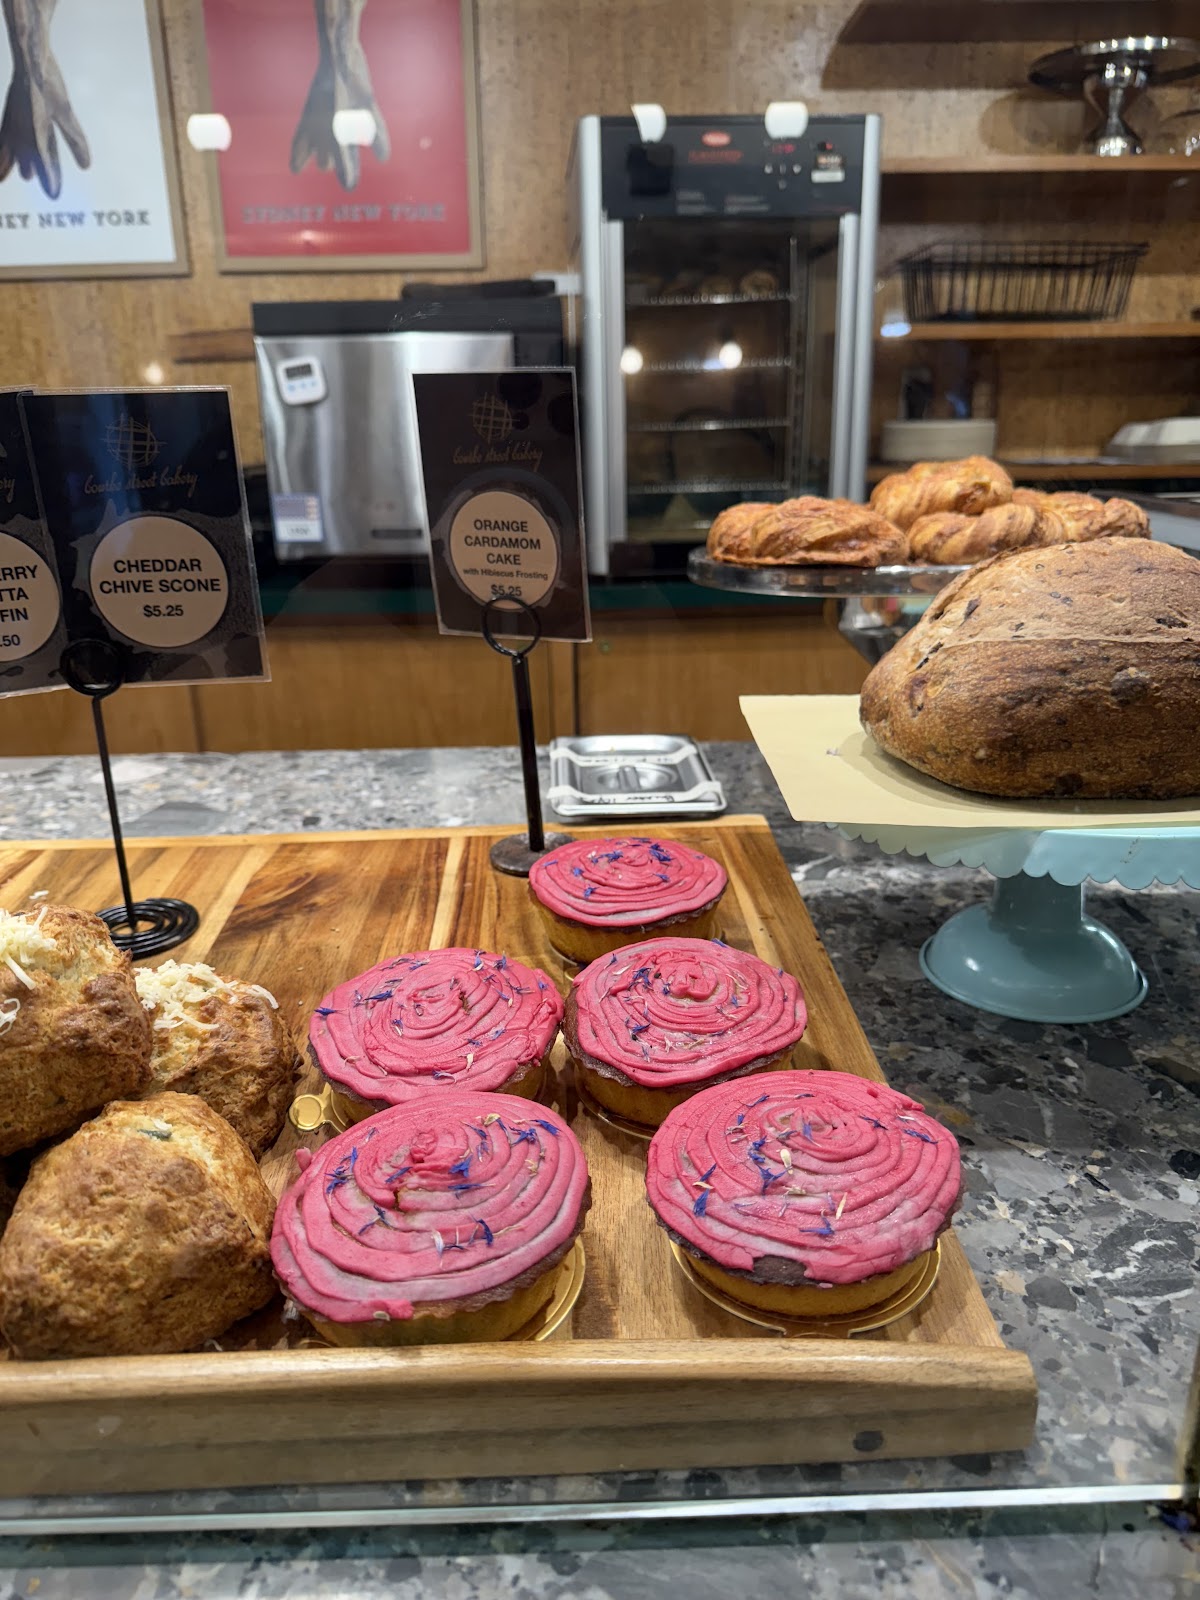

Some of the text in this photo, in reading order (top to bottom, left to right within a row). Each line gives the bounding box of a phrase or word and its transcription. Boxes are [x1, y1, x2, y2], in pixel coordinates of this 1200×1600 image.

[0, 208, 152, 229] EY NEW YORK
[242, 203, 446, 224] SYDNEY NEW YORK
[473, 518, 529, 532] ORANGE
[464, 535, 541, 550] CARDAMOM
[113, 558, 202, 574] CHEDDAR
[486, 552, 521, 566] CAKE
[0, 565, 38, 581] RRY
[463, 568, 548, 581] with Hibiscus Frosting
[99, 577, 222, 595] CHIVE SCONE
[490, 584, 522, 597] $5.25
[143, 604, 184, 618] $5.25
